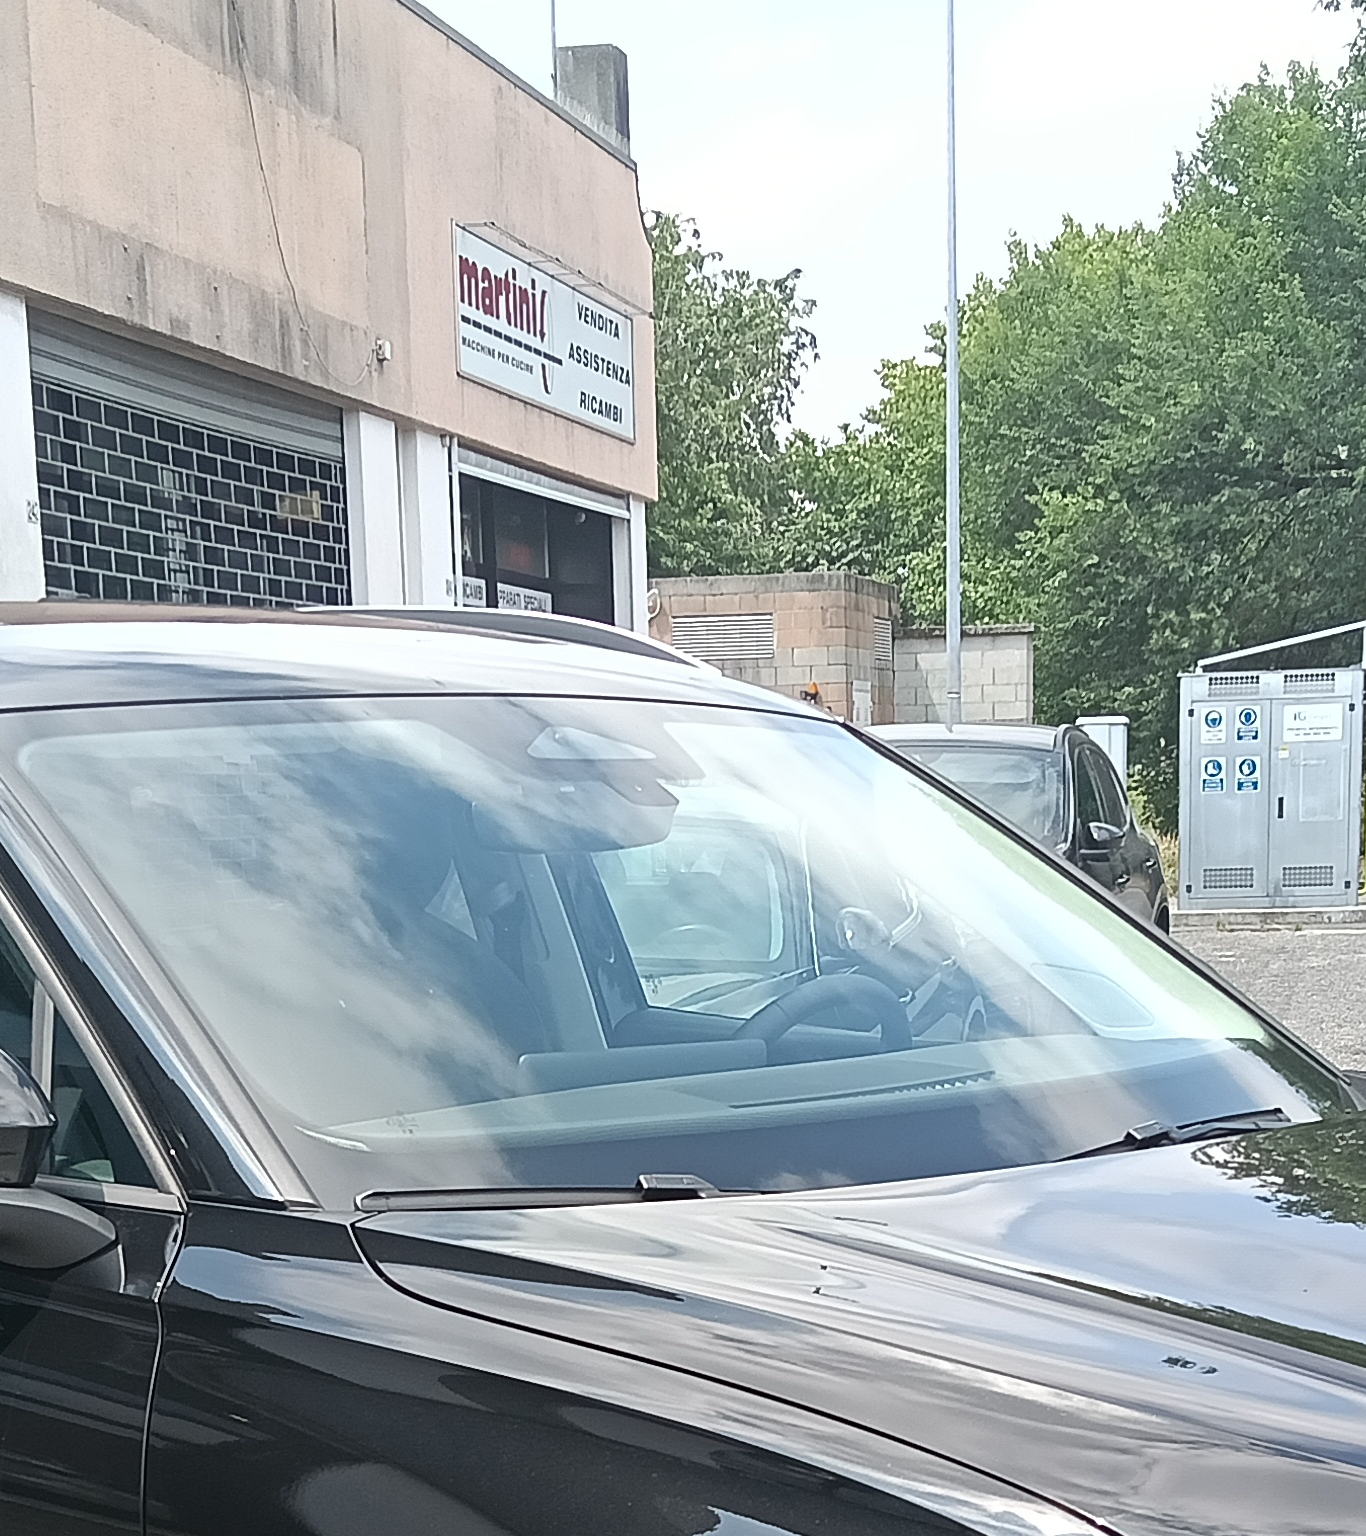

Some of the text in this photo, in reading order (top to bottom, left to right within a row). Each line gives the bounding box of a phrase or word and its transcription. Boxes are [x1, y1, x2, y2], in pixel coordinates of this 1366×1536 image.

[577, 301, 620, 340] VENDITA
[461, 335, 534, 375] MACCHINE PER CUCIRE
[568, 342, 631, 387] ASSISTENZA
[580, 391, 623, 424] RICAMBI
